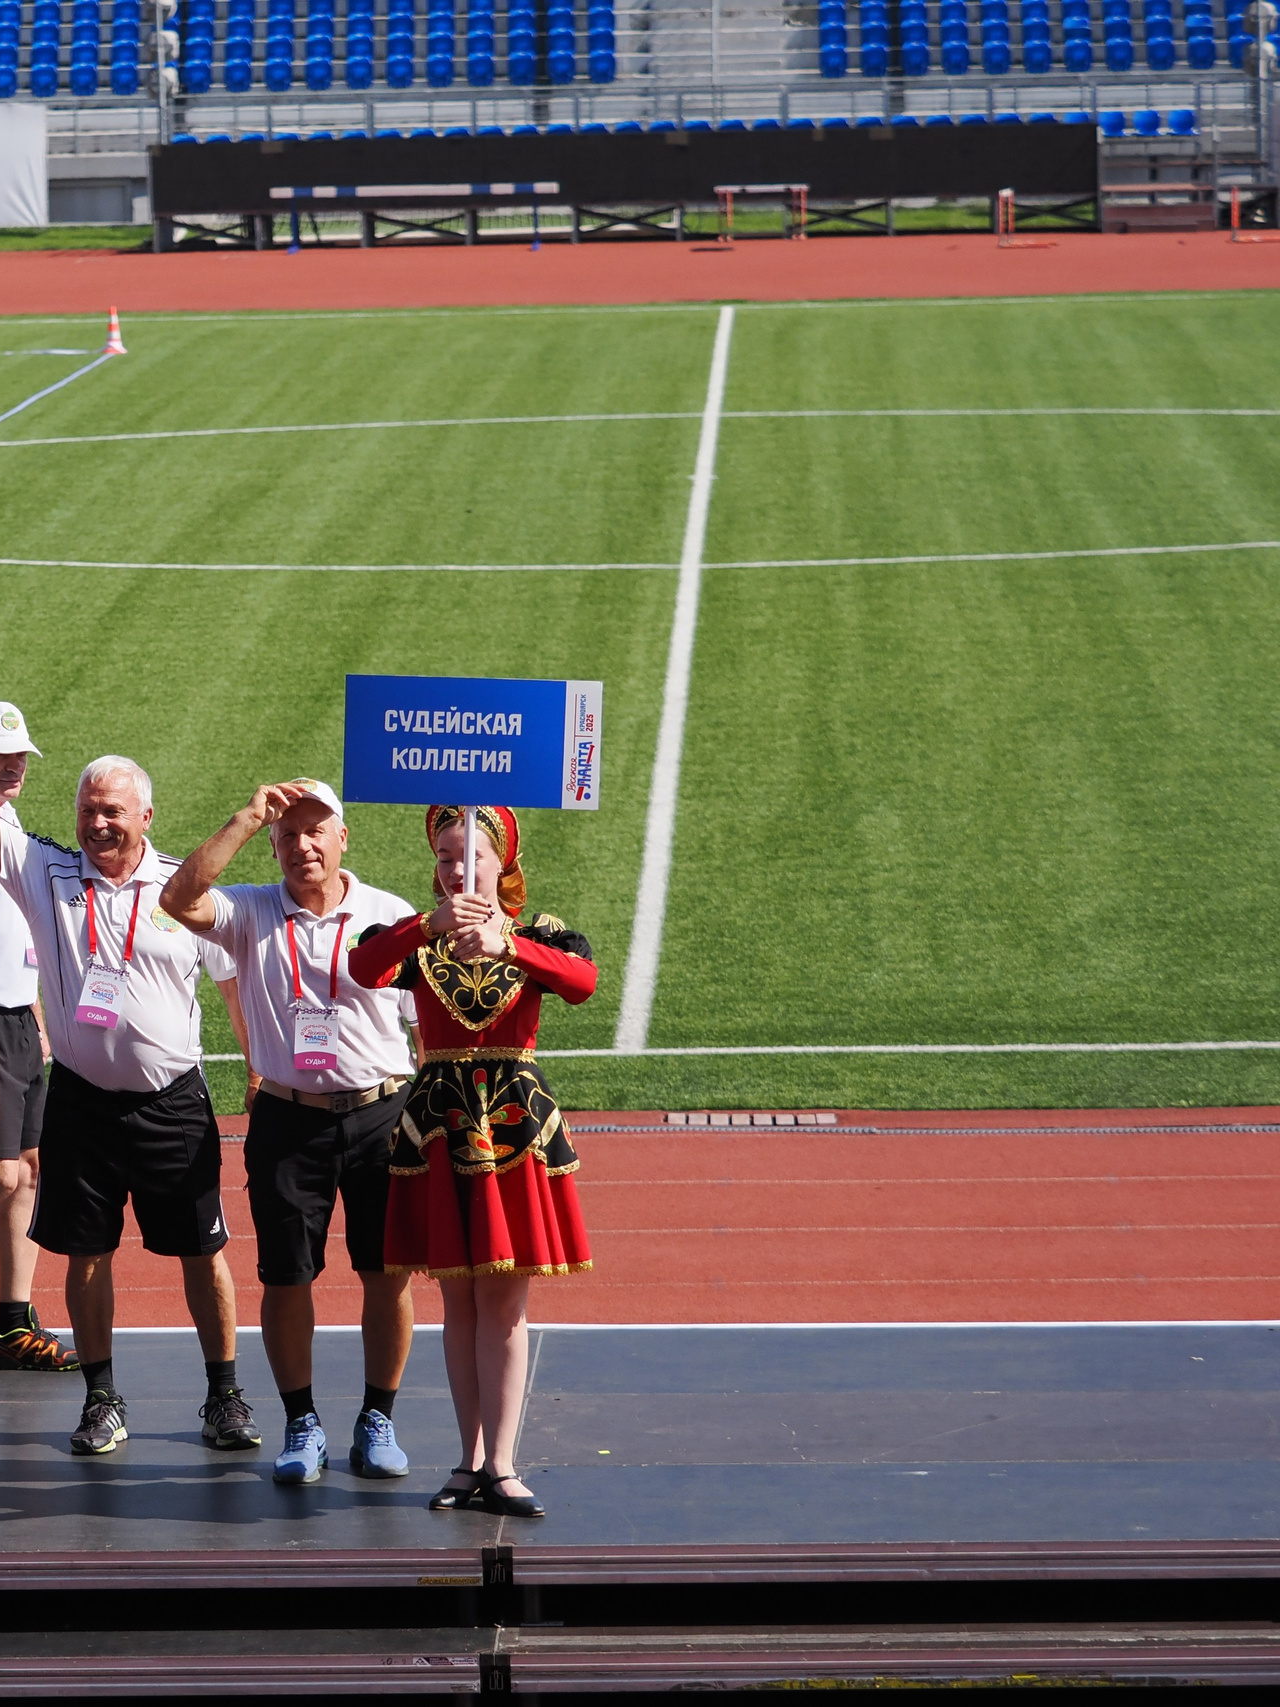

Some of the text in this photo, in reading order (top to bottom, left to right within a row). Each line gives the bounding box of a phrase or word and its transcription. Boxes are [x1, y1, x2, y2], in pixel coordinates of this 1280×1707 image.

[384, 706, 522, 736] СУДЕЙСКАЯ
[579, 693, 587, 732] КРАСНОЯРСК
[586, 714, 594, 732] 2025
[392, 747, 512, 773] КОЛЛЕГИЯ
[566, 756, 578, 794] Русская
[577, 741, 593, 789] ЛАПТА
[86, 1012, 108, 1022] СУДЬЯ
